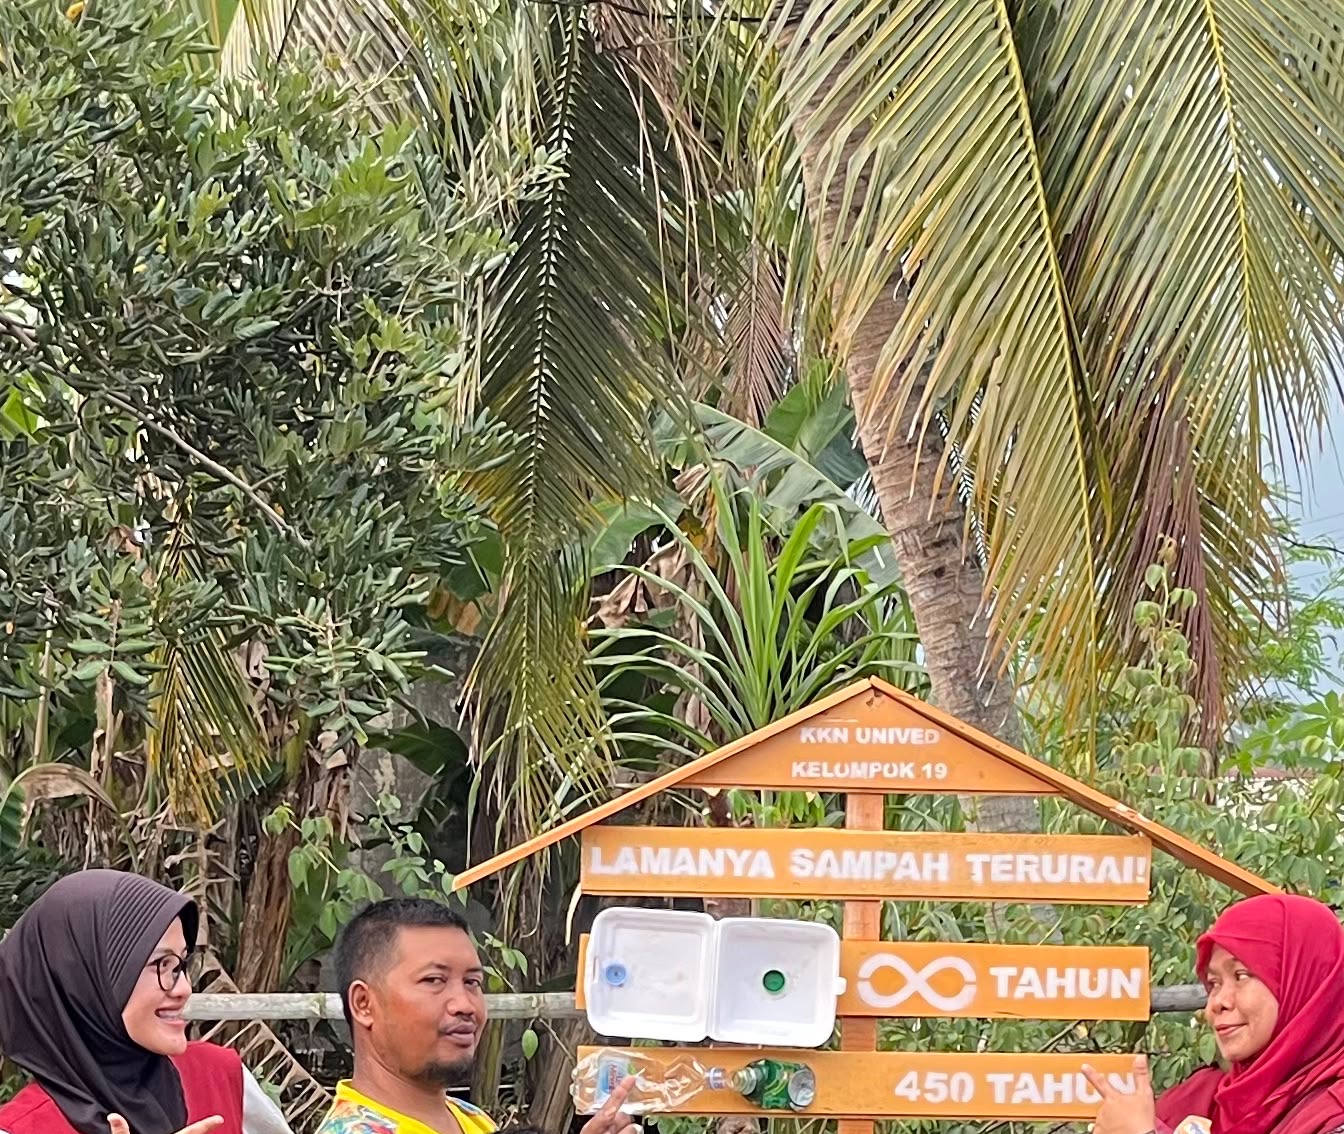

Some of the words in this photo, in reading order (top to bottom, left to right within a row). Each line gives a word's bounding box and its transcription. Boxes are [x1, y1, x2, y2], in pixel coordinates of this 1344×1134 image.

[800, 727, 849, 744] KKN
[856, 727, 940, 745] UNIVED
[921, 762, 948, 779] 19
[590, 846, 775, 879] LAMANYA
[789, 848, 949, 882] SAMPAH
[965, 853, 1147, 885] TERURAI!
[989, 965, 1142, 999] TAHUN
[895, 1071, 974, 1103] 450
